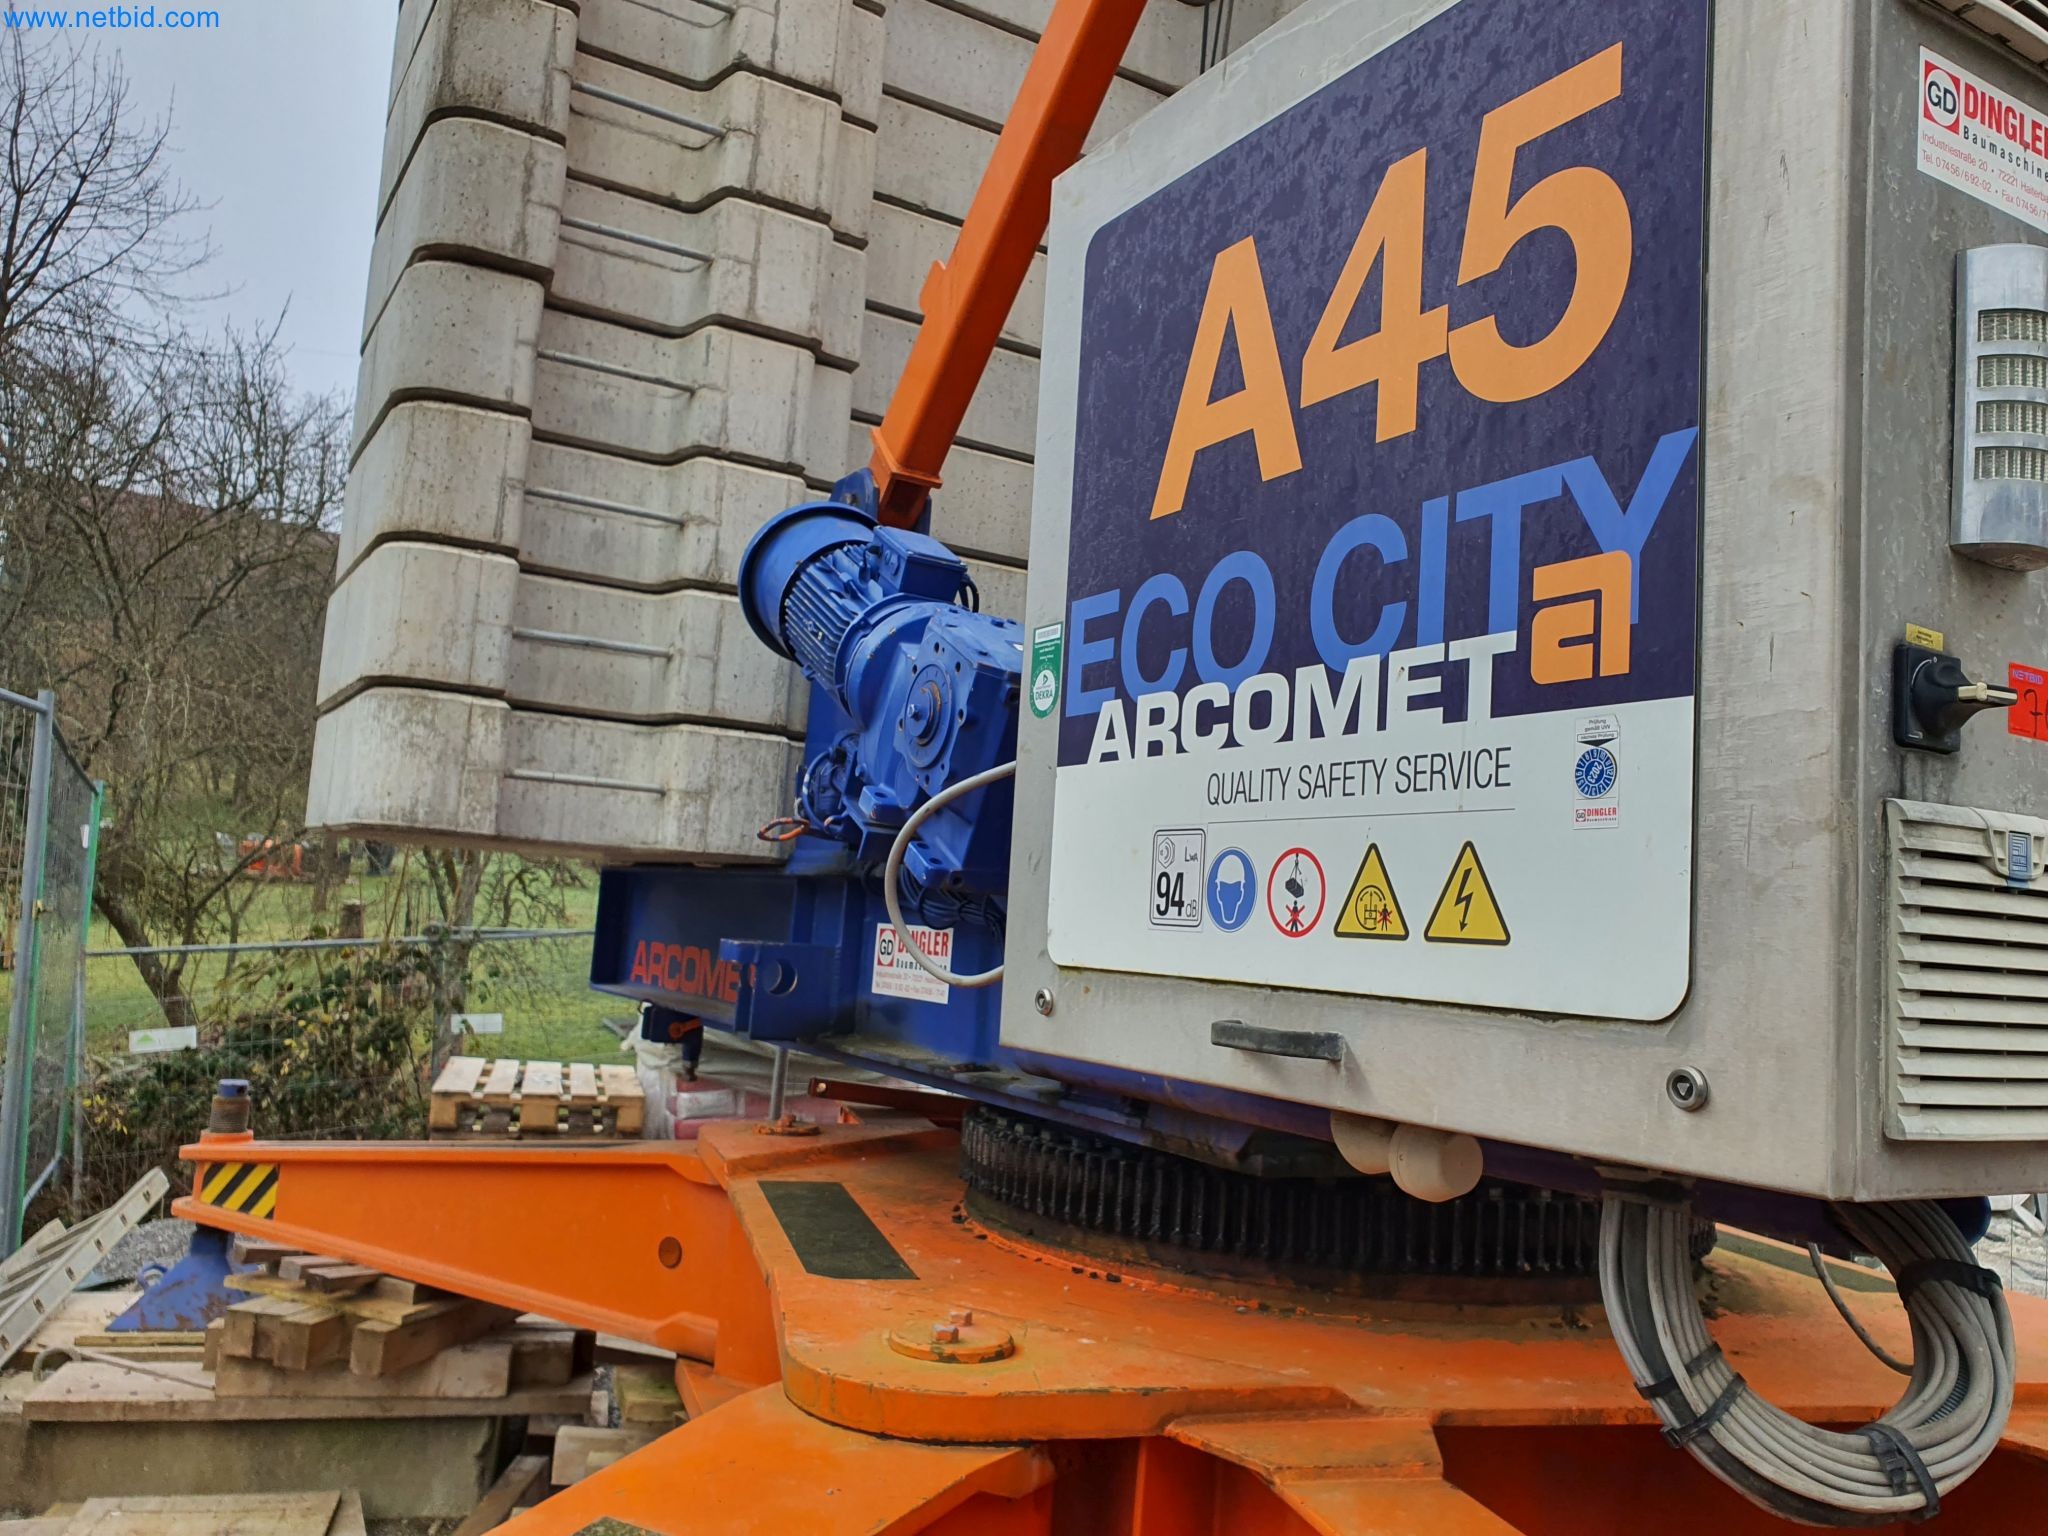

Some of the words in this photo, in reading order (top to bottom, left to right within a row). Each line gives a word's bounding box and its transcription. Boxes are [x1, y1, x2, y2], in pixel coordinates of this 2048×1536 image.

[1928, 81, 1957, 115] GD
[1964, 82, 2048, 160] DINGLE
[1922, 131, 1976, 166] Industriestraße
[1978, 159, 1988, 172] 20
[1150, 41, 1632, 520] A45
[1066, 550, 1276, 717] ECO
[1311, 426, 1699, 673] CITY
[1087, 630, 1517, 764] ARCOMET
[1207, 767, 1291, 806] QUALITY
[1298, 758, 1387, 799] SAFETY
[1395, 747, 1511, 793] SERVICE
[1586, 808, 1617, 817] DINGLER
[1156, 872, 1185, 917] 94
[1185, 899, 1197, 918] dB
[880, 939, 893, 955] GD
